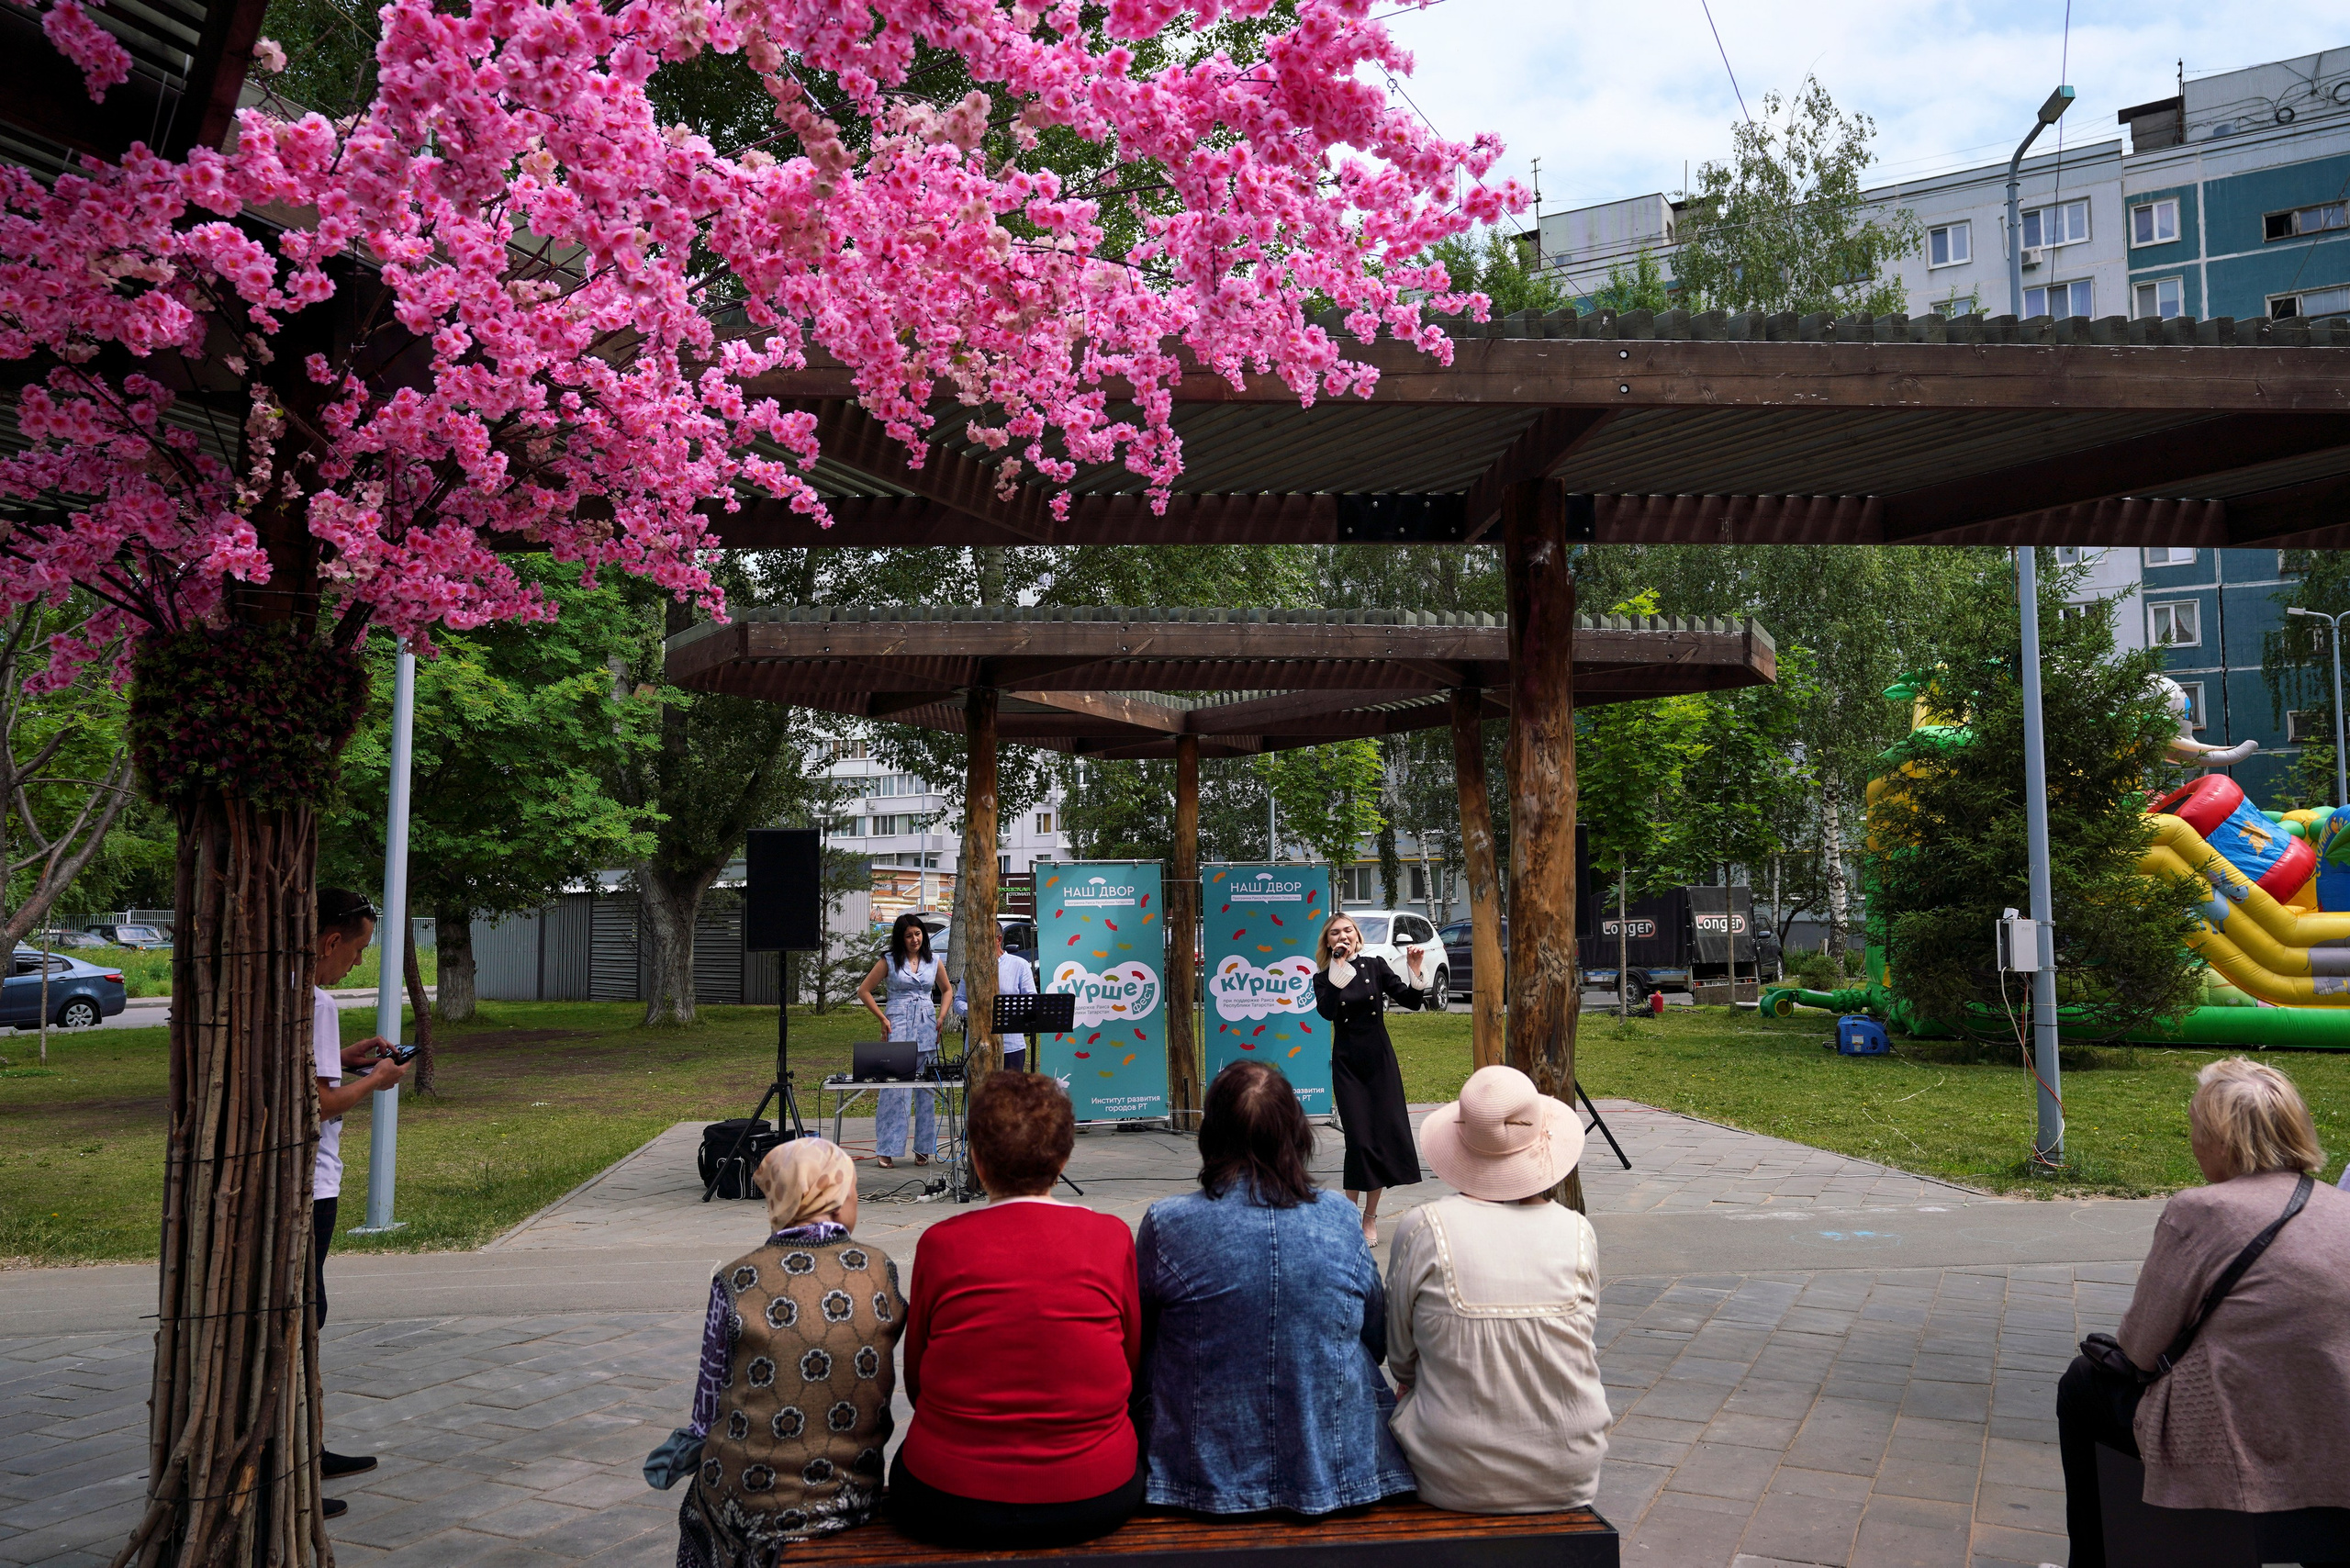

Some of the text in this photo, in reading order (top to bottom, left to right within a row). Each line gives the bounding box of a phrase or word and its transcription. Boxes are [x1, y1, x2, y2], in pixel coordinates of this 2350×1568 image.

[1064, 886, 1135, 898] НАШ ДВОР
[1230, 882, 1302, 893] НАШ ДВОР
[1298, 980, 1315, 1006] фес
[1132, 985, 1154, 1013] фест
[1091, 1095, 1161, 1104] Институт развития
[1104, 1103, 1148, 1113] городов РТ
